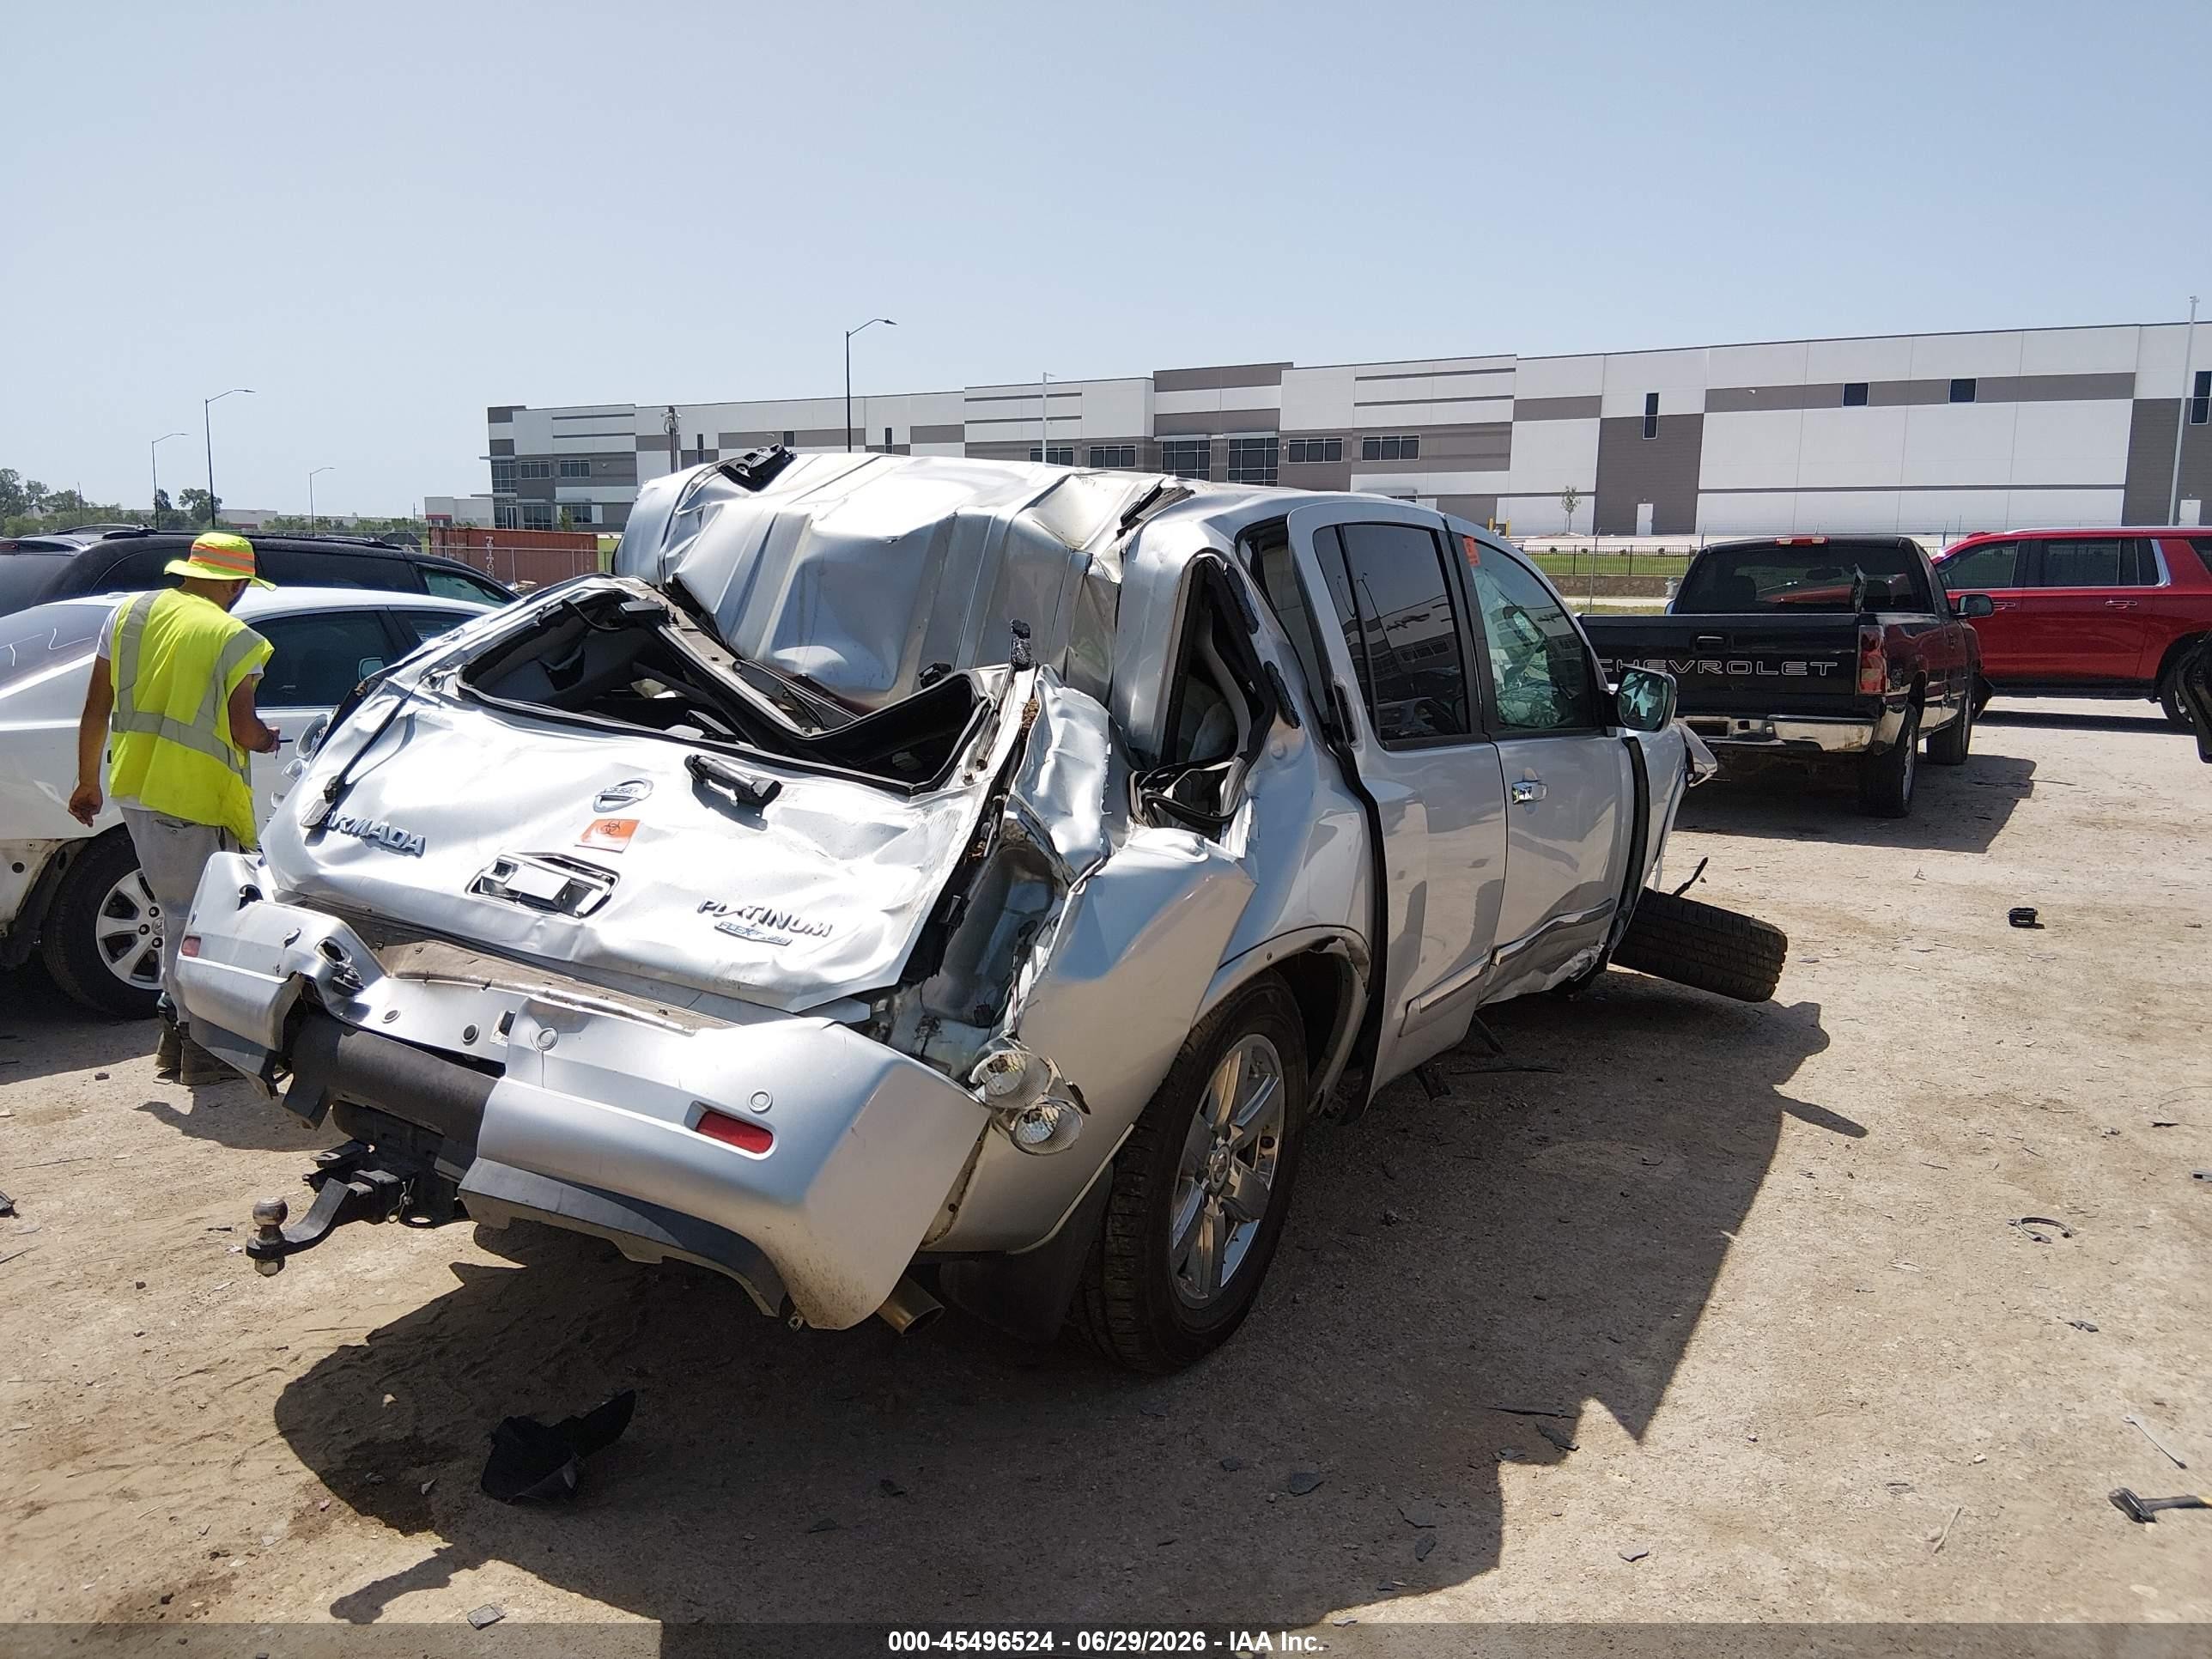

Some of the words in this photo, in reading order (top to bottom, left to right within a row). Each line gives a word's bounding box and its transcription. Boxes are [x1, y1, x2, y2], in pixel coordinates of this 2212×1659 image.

[486, 536, 495, 577] TRITON
[1598, 659, 1838, 676] CHEVROLET
[697, 899, 832, 937] PLATINUM
